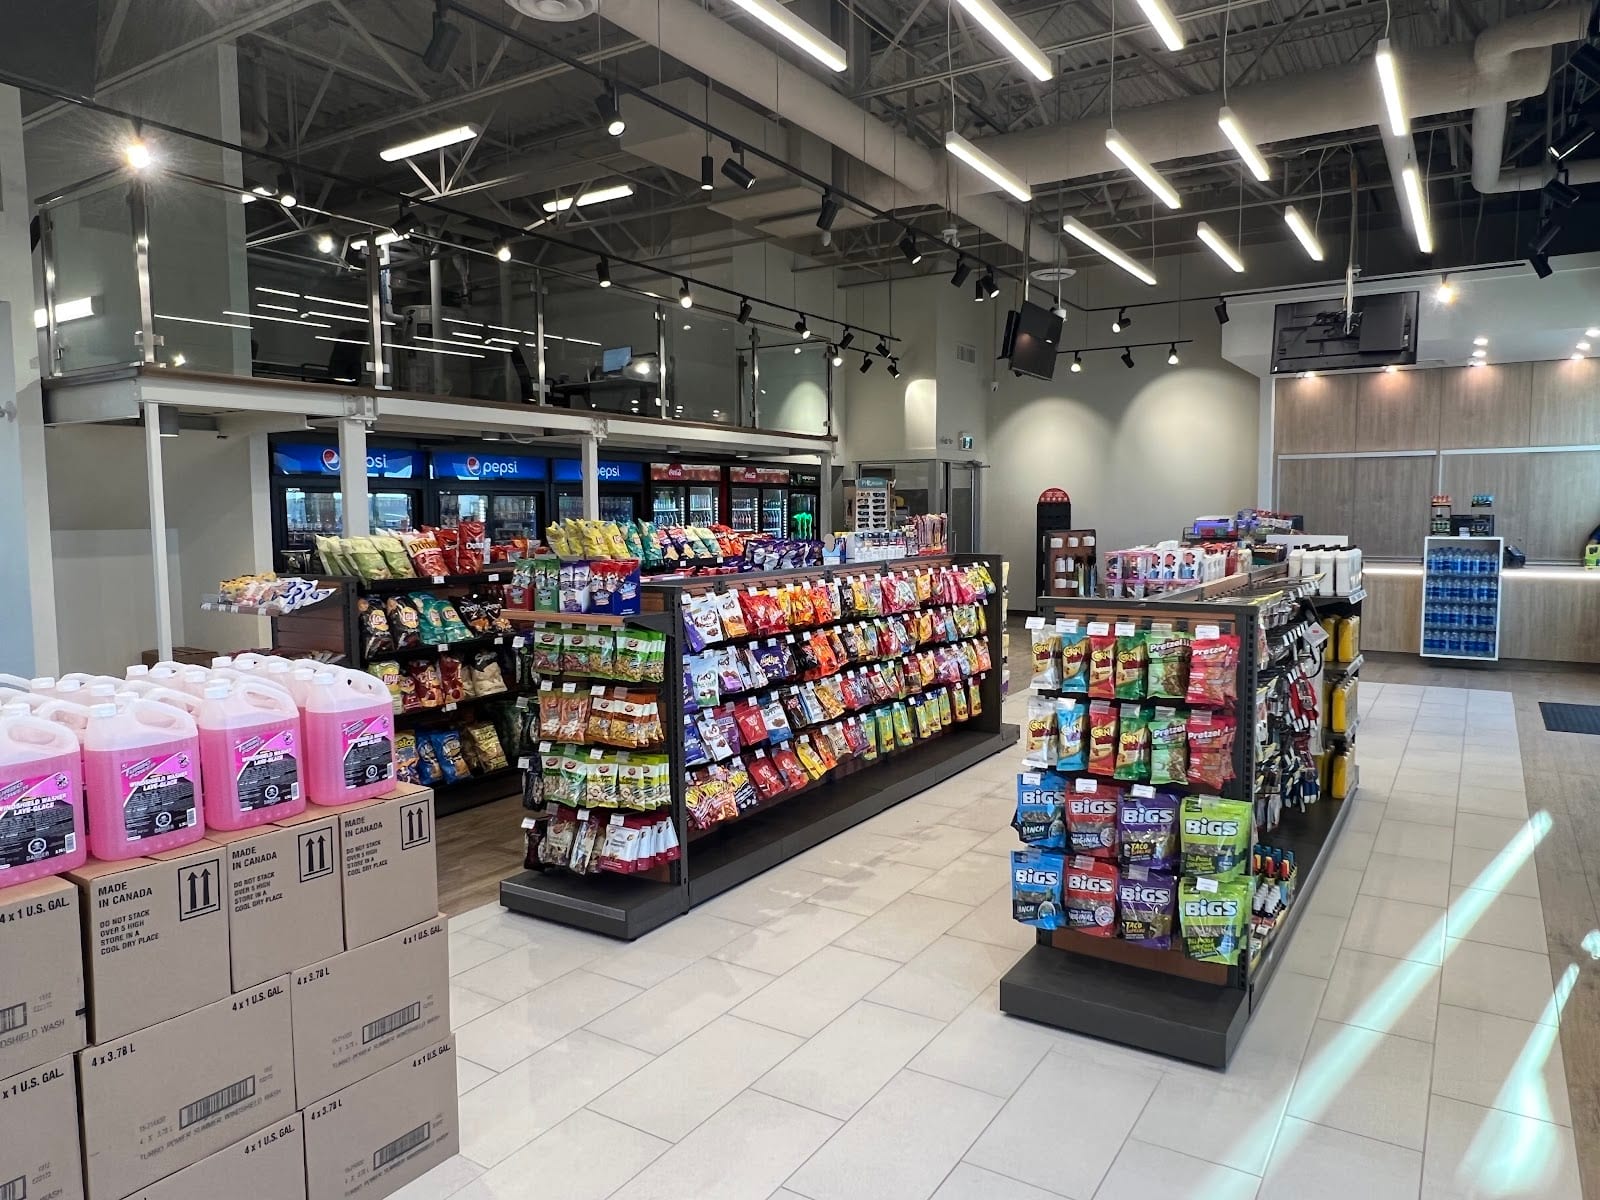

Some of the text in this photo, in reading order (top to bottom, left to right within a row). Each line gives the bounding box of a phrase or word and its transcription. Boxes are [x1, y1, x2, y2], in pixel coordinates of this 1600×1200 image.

[483, 461, 518, 476] pepsi
[597, 465, 620, 479] epsi
[345, 816, 365, 828] MADE
[355, 821, 383, 835] CANADA
[232, 846, 257, 860] MADE
[1131, 843, 1149, 851] TACO
[232, 851, 277, 871] IN CANADA
[98, 881, 128, 897] MADE
[98, 887, 153, 909] IN CANADA
[265, 893, 284, 903] PLACE
[0, 913, 5, 923] 4
[8, 912, 15, 922] x
[17, 908, 22, 919] 1
[26, 903, 46, 917] U.S.
[100, 909, 150, 929] DO NOT STACK
[100, 920, 145, 938] OVER 5 HIGH
[100, 934, 124, 947] STORE
[126, 931, 133, 940] IN
[101, 932, 160, 956] COOL DRY PLACE
[297, 977, 302, 985] 4
[325, 967, 330, 976] L
[232, 1002, 238, 1011] 4
[239, 1001, 244, 1010] x
[245, 997, 249, 1006] 1
[251, 992, 266, 1004] U.S.
[40, 1018, 65, 1034] WASH
[91, 1057, 98, 1067] 4
[107, 1045, 128, 1062] 3.78
[130, 1043, 136, 1053] L
[2, 1090, 9, 1099] x
[11, 1084, 17, 1096] 1
[20, 1077, 40, 1092] U.S.
[311, 1112, 316, 1120] 4
[338, 1098, 343, 1107] L
[244, 1145, 250, 1154] 4
[257, 1139, 262, 1148] 1
[263, 1132, 278, 1146] U.S.
